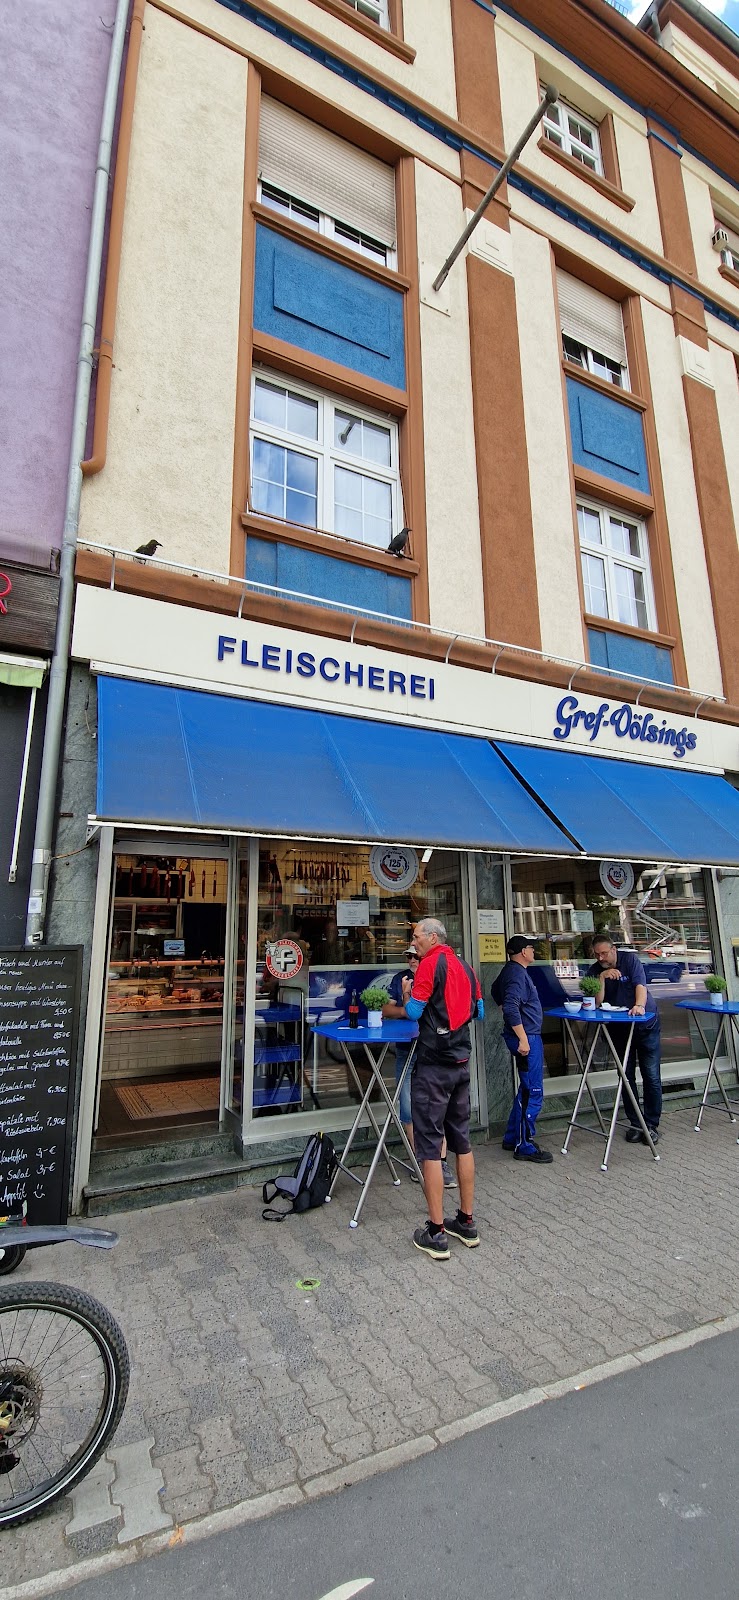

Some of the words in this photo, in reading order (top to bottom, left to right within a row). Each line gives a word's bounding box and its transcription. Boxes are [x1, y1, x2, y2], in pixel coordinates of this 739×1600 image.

[217, 635, 435, 700] FLEISCHEREI
[553, 696, 697, 758] Gref-Völsings
[389, 859, 401, 868] 125
[7, 1168, 31, 1180] Salat
